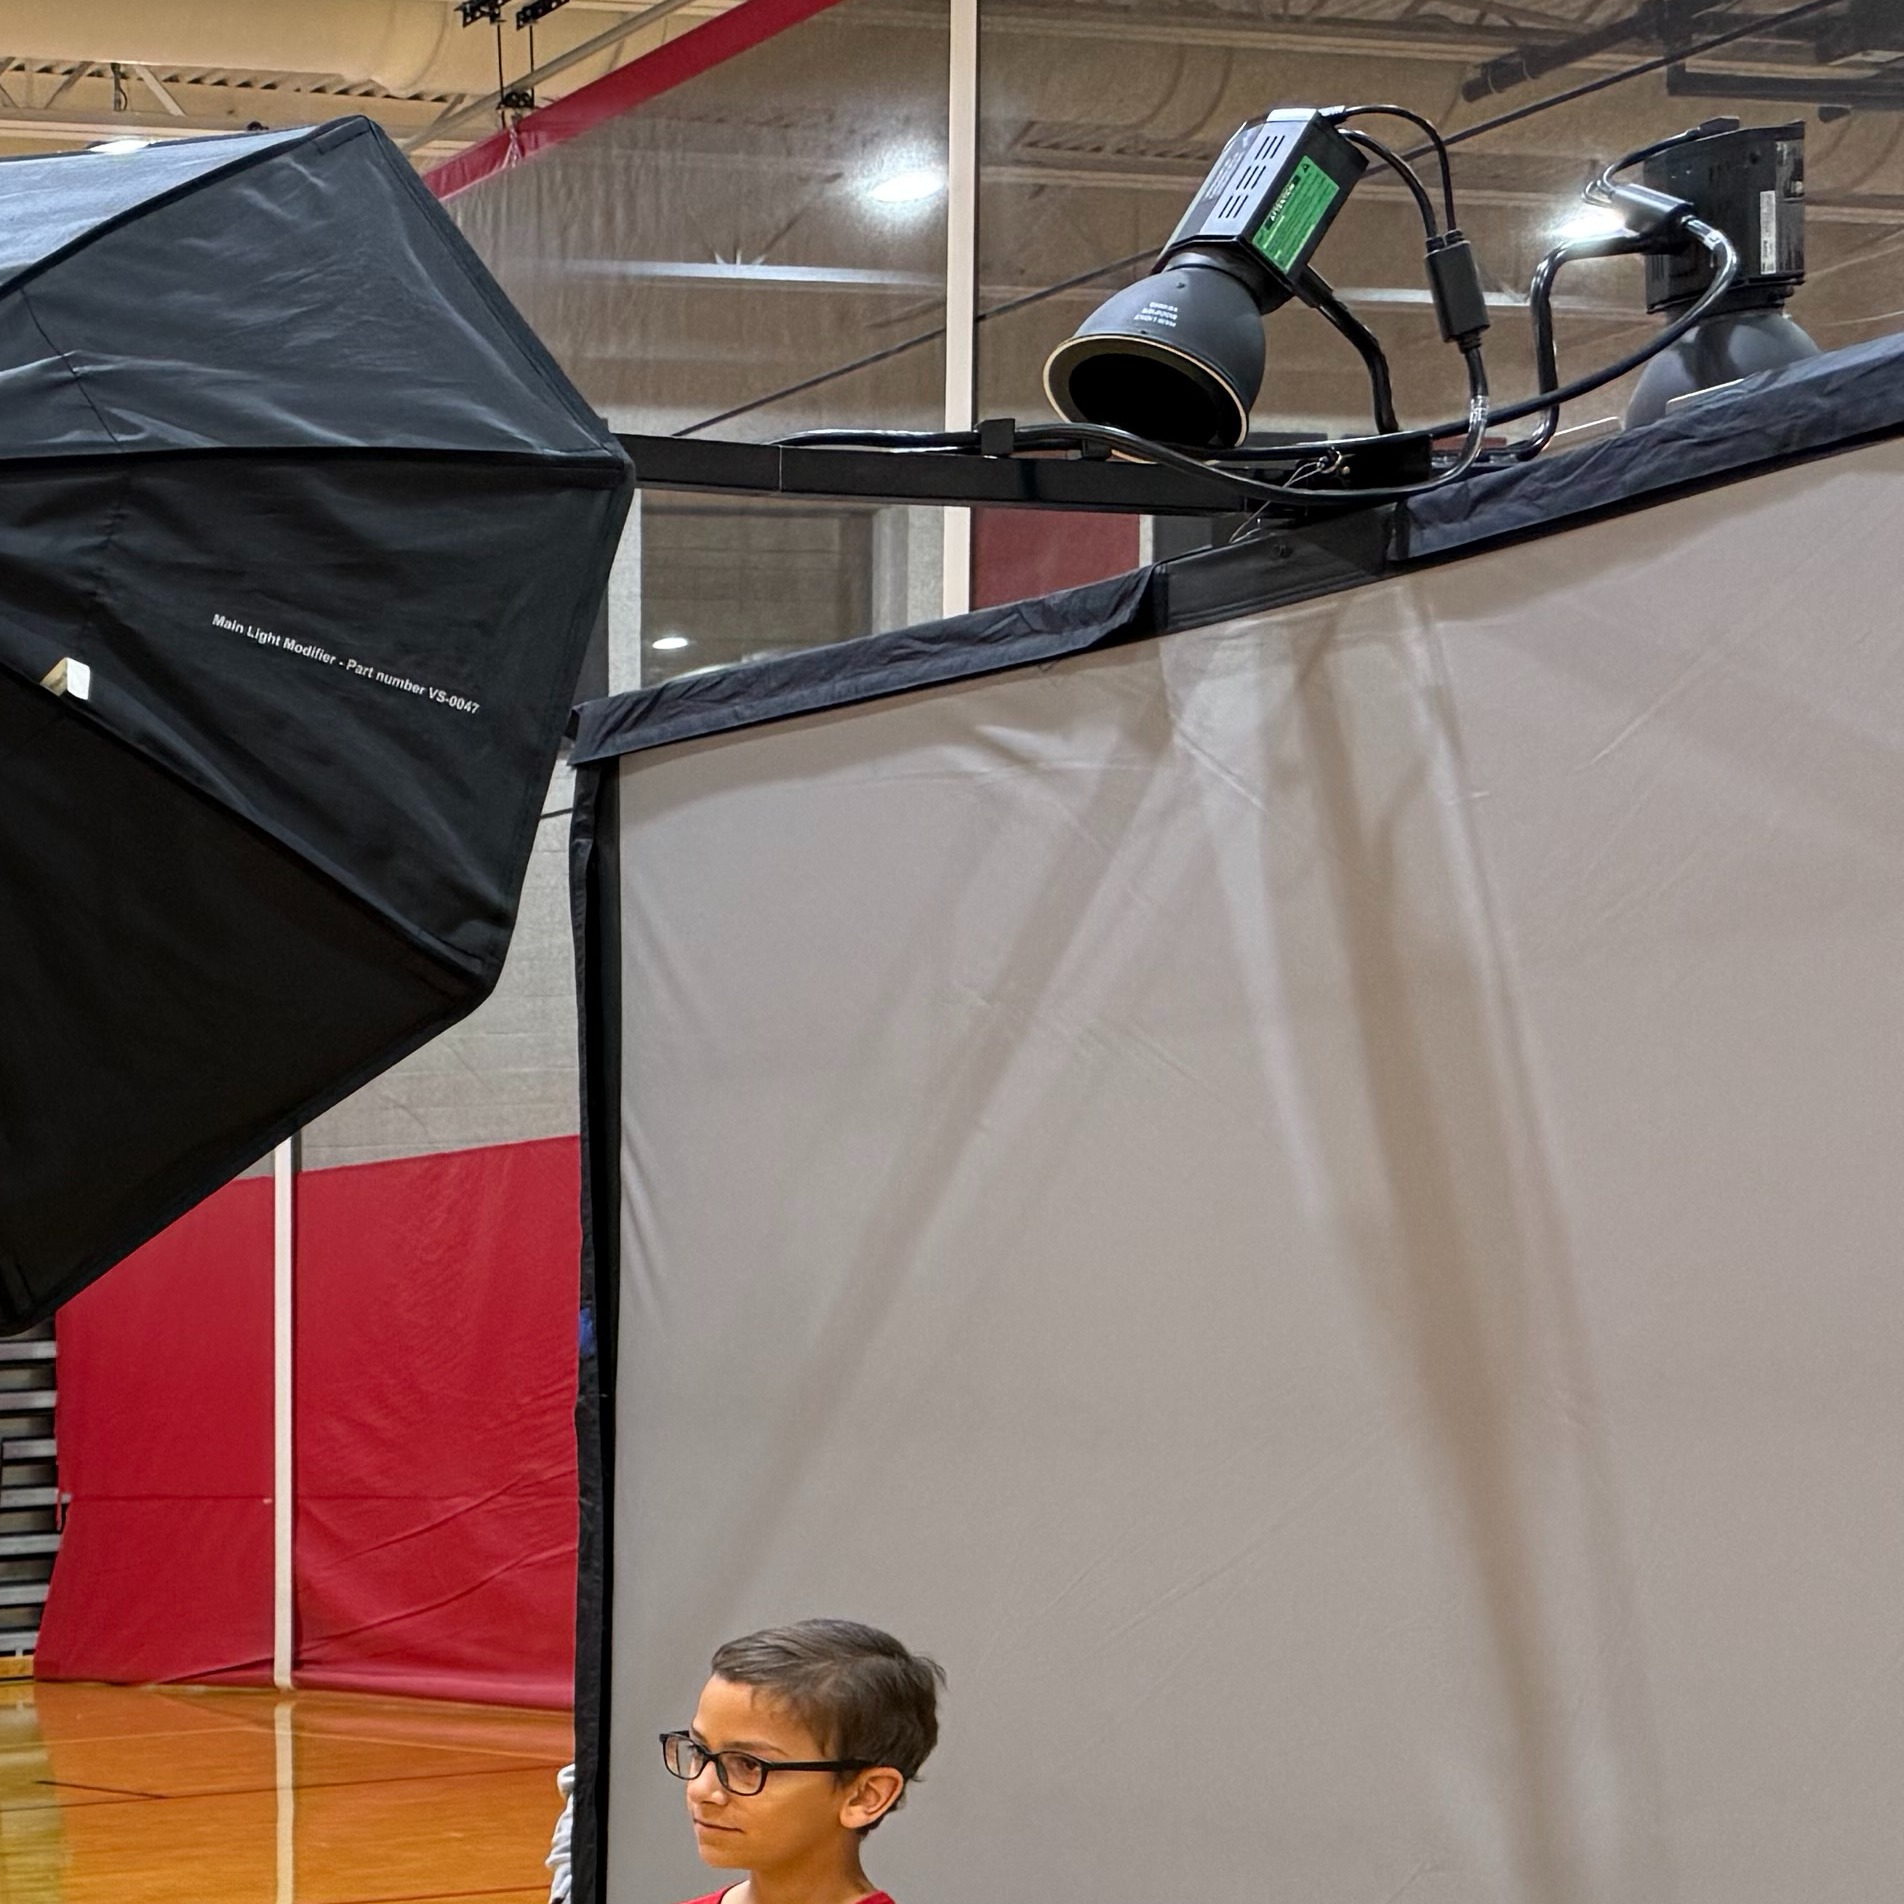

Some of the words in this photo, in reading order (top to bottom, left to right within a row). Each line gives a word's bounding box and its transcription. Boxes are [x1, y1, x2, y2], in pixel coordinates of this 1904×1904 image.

[212, 613, 245, 635] Main
[247, 624, 282, 647] Light
[283, 636, 337, 666] Modifier
[346, 658, 374, 679] Part
[376, 670, 427, 696] number
[428, 686, 481, 715] VS-0047
